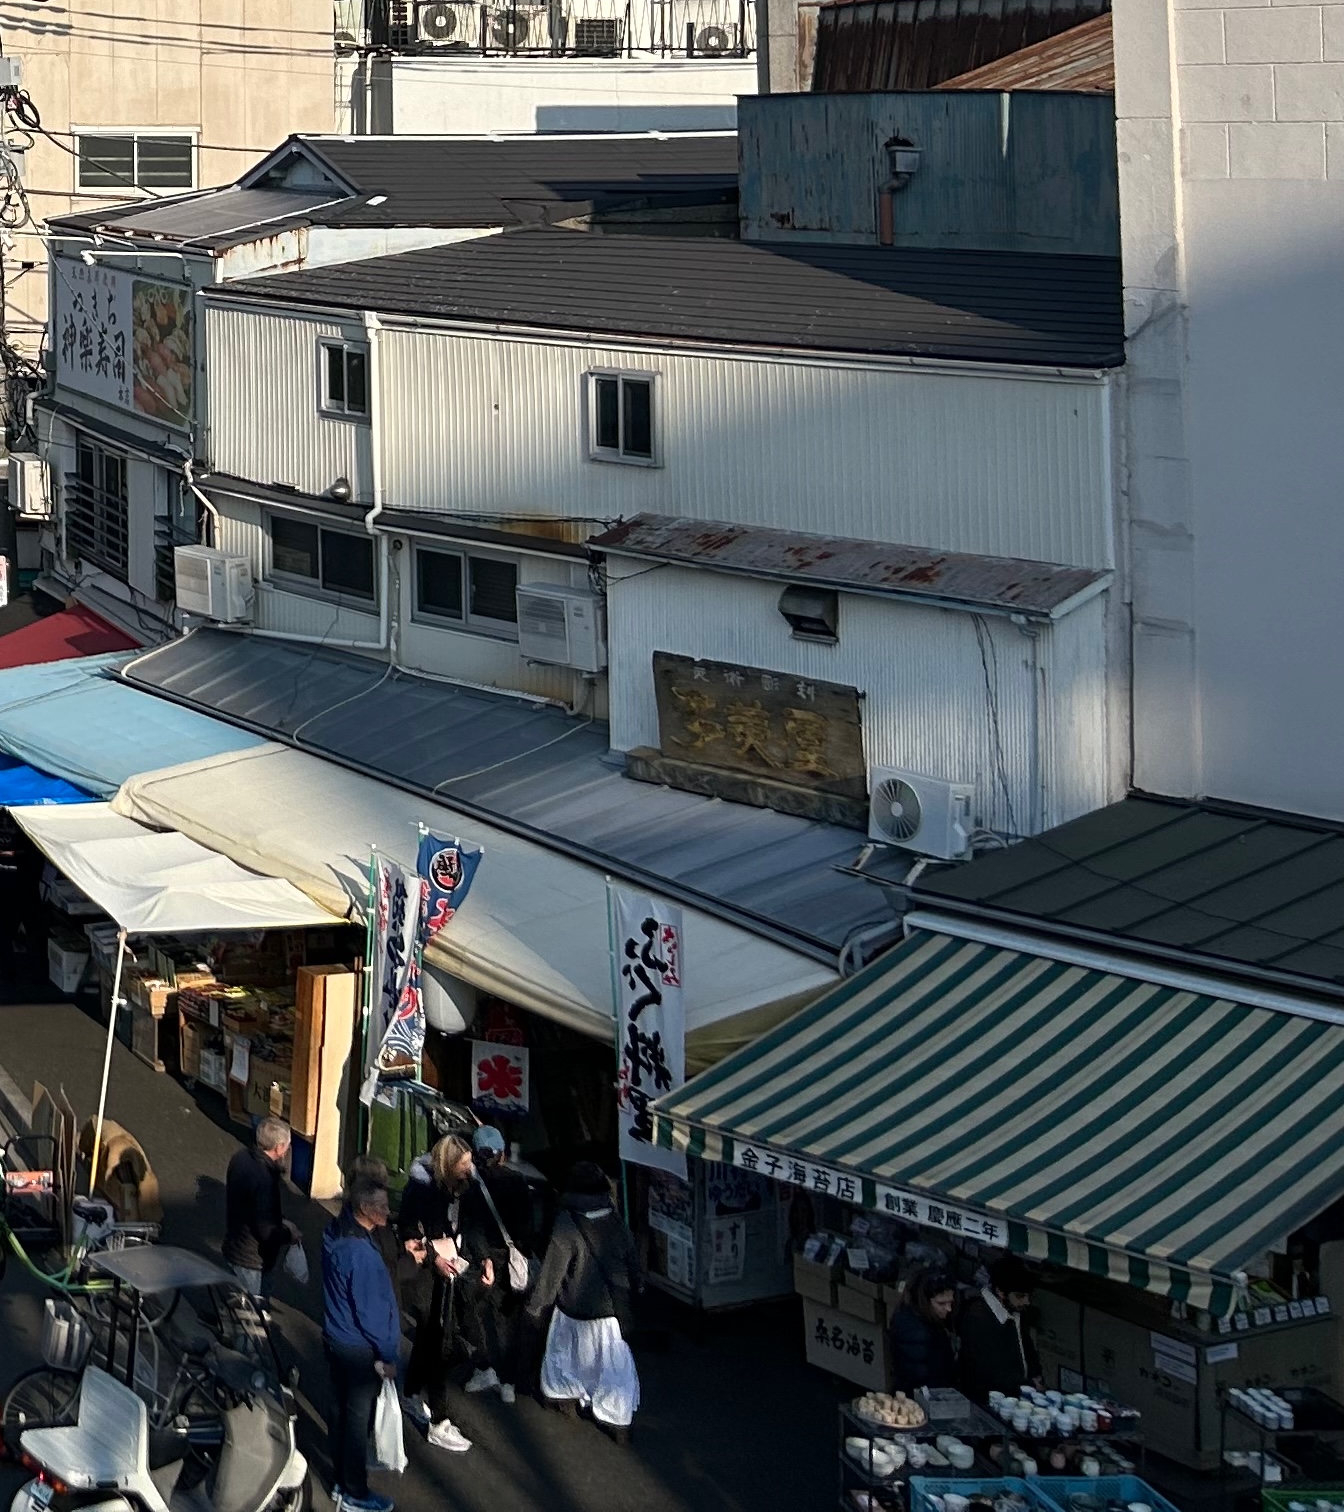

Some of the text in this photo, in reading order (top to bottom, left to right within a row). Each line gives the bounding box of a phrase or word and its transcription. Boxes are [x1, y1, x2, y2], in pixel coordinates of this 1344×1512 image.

[740, 1147, 856, 1201] 金子海苔店
[884, 1192, 1000, 1241] 創業 慶應二年
